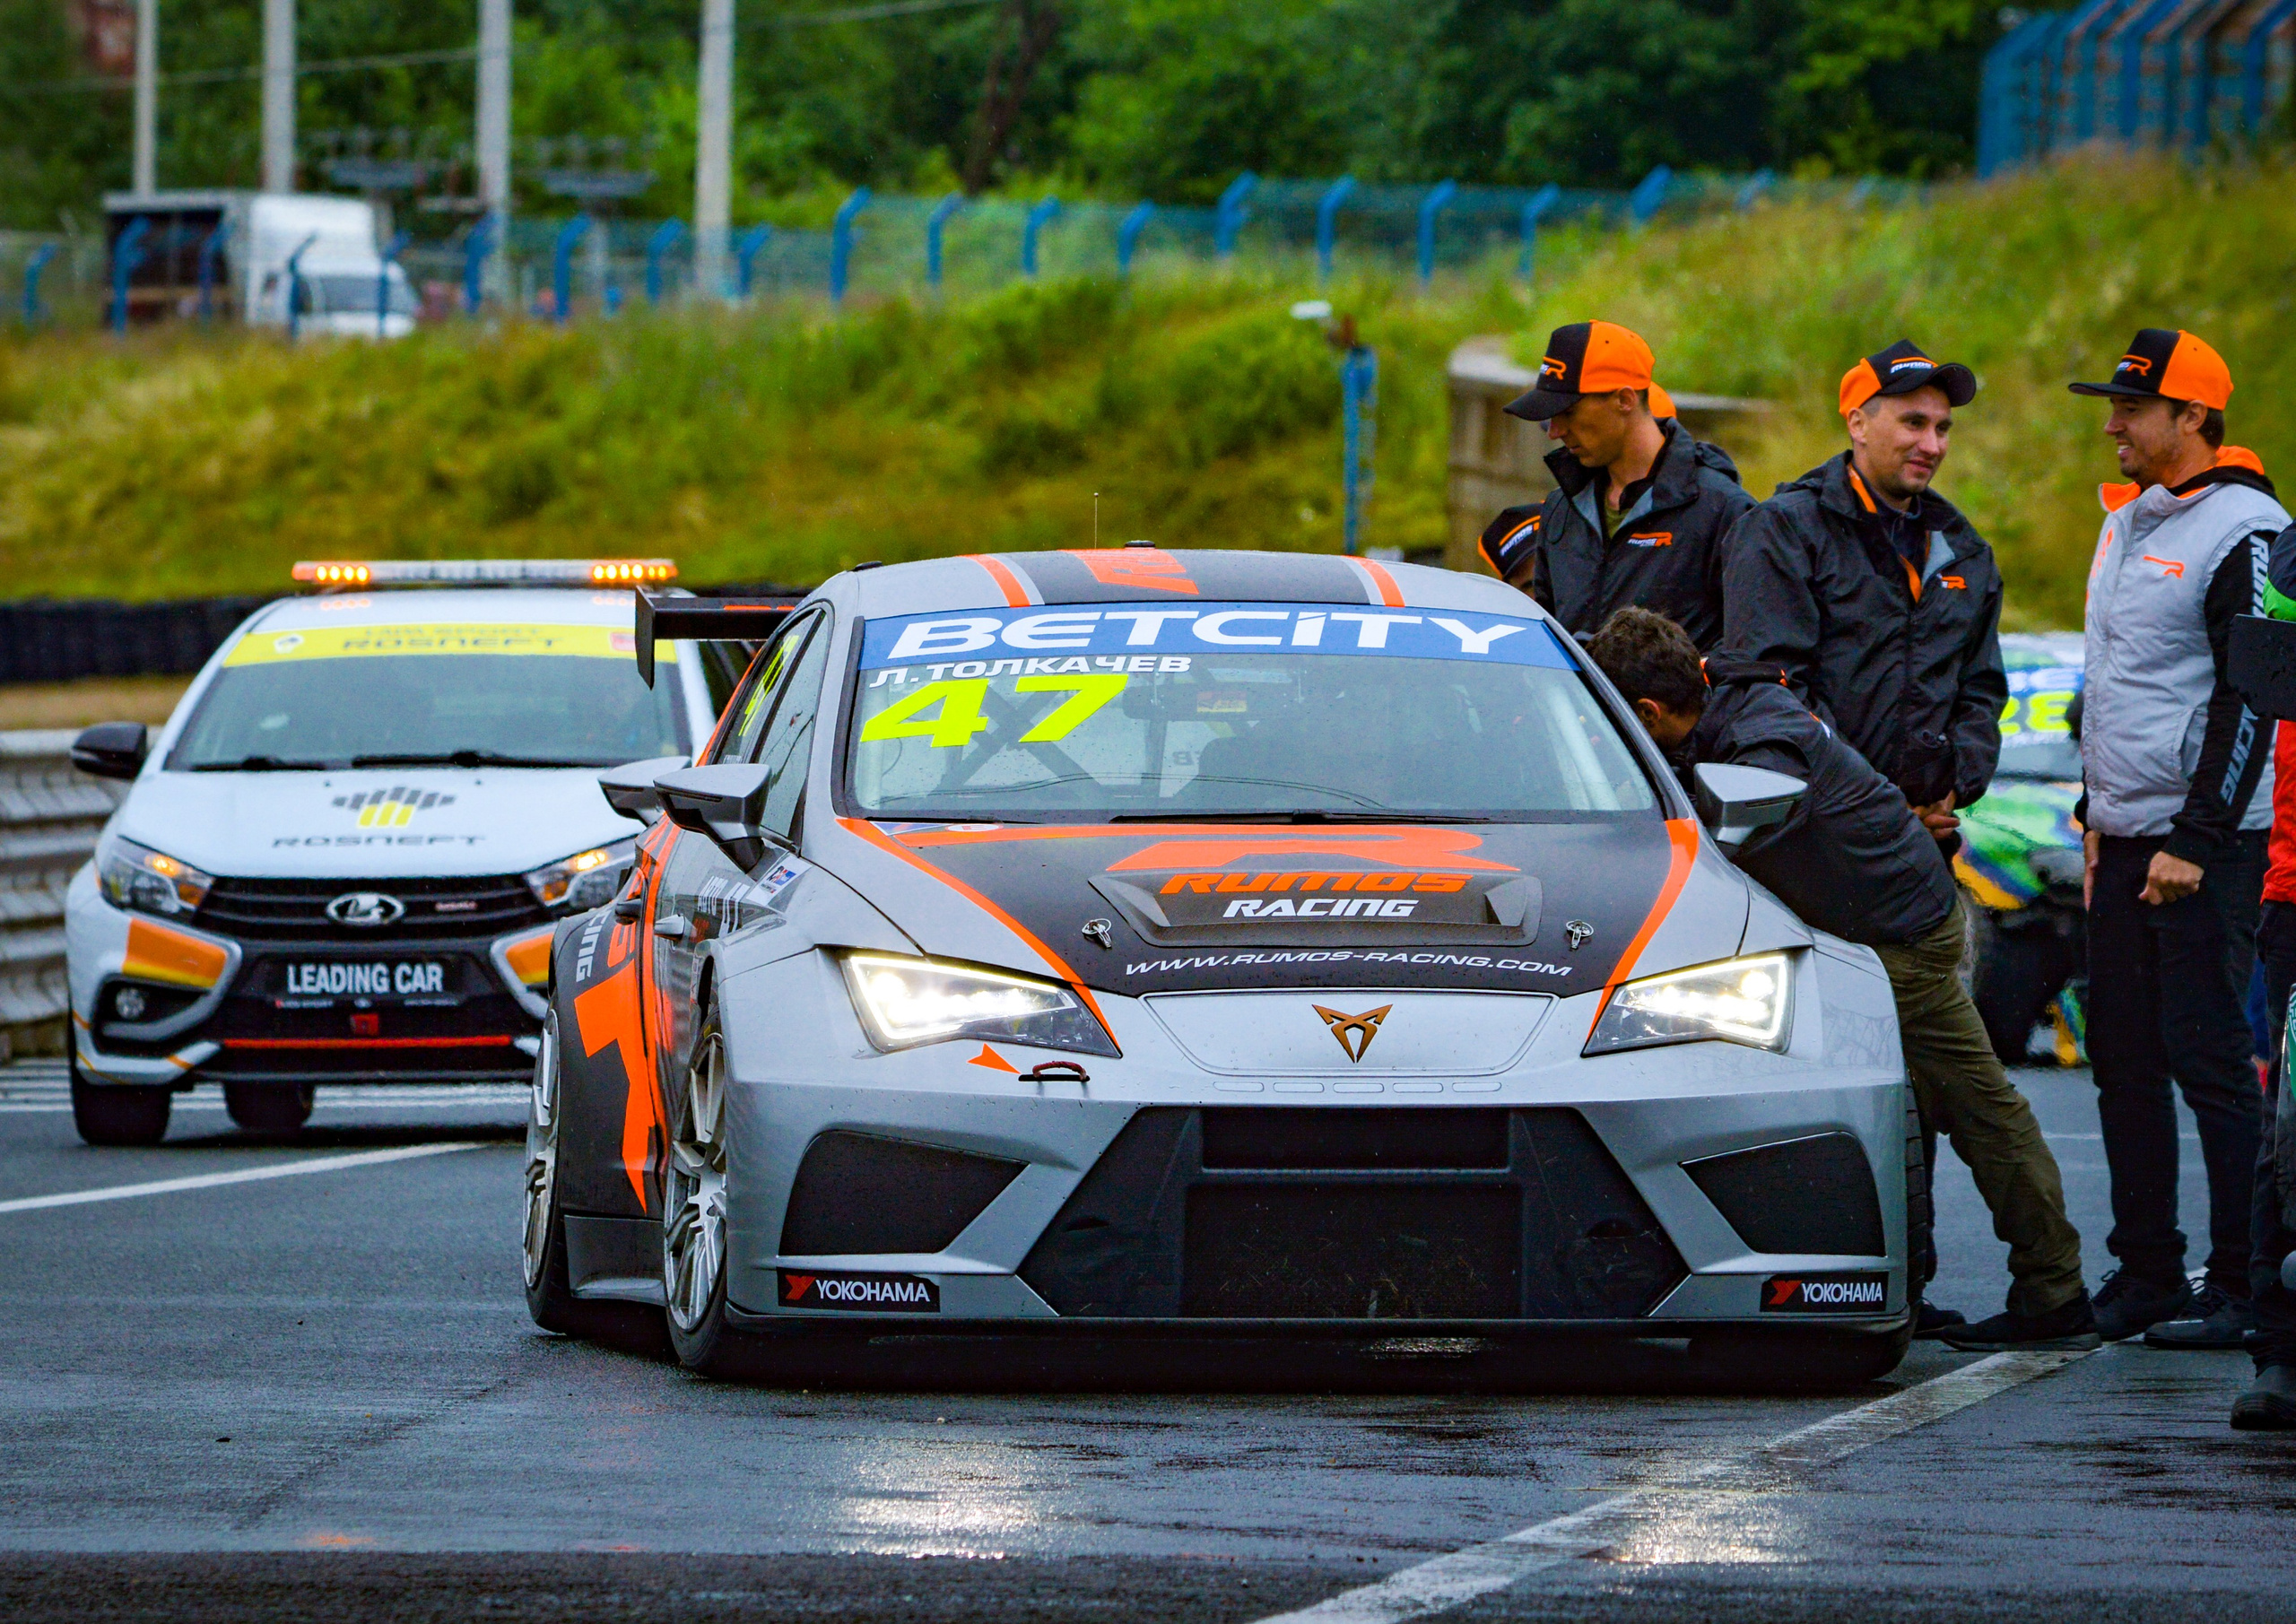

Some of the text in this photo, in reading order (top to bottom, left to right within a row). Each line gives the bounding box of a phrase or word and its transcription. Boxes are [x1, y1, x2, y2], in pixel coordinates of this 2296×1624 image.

[342, 637, 563, 649] ROSNEFT
[887, 611, 1527, 659] BETCITY
[861, 673, 1129, 748] 47
[2220, 703, 2259, 806] CING
[273, 836, 485, 848] ROSNEFT
[1160, 872, 1474, 894] RUMOS
[1222, 899, 1420, 919] RACING
[1126, 951, 1573, 977] WWW.RUMOS-RACING.COM
[286, 962, 443, 994] LEADING CAR
[815, 1279, 930, 1302] YOKOHAMA
[1801, 1281, 1883, 1303] YOKOHAMA
